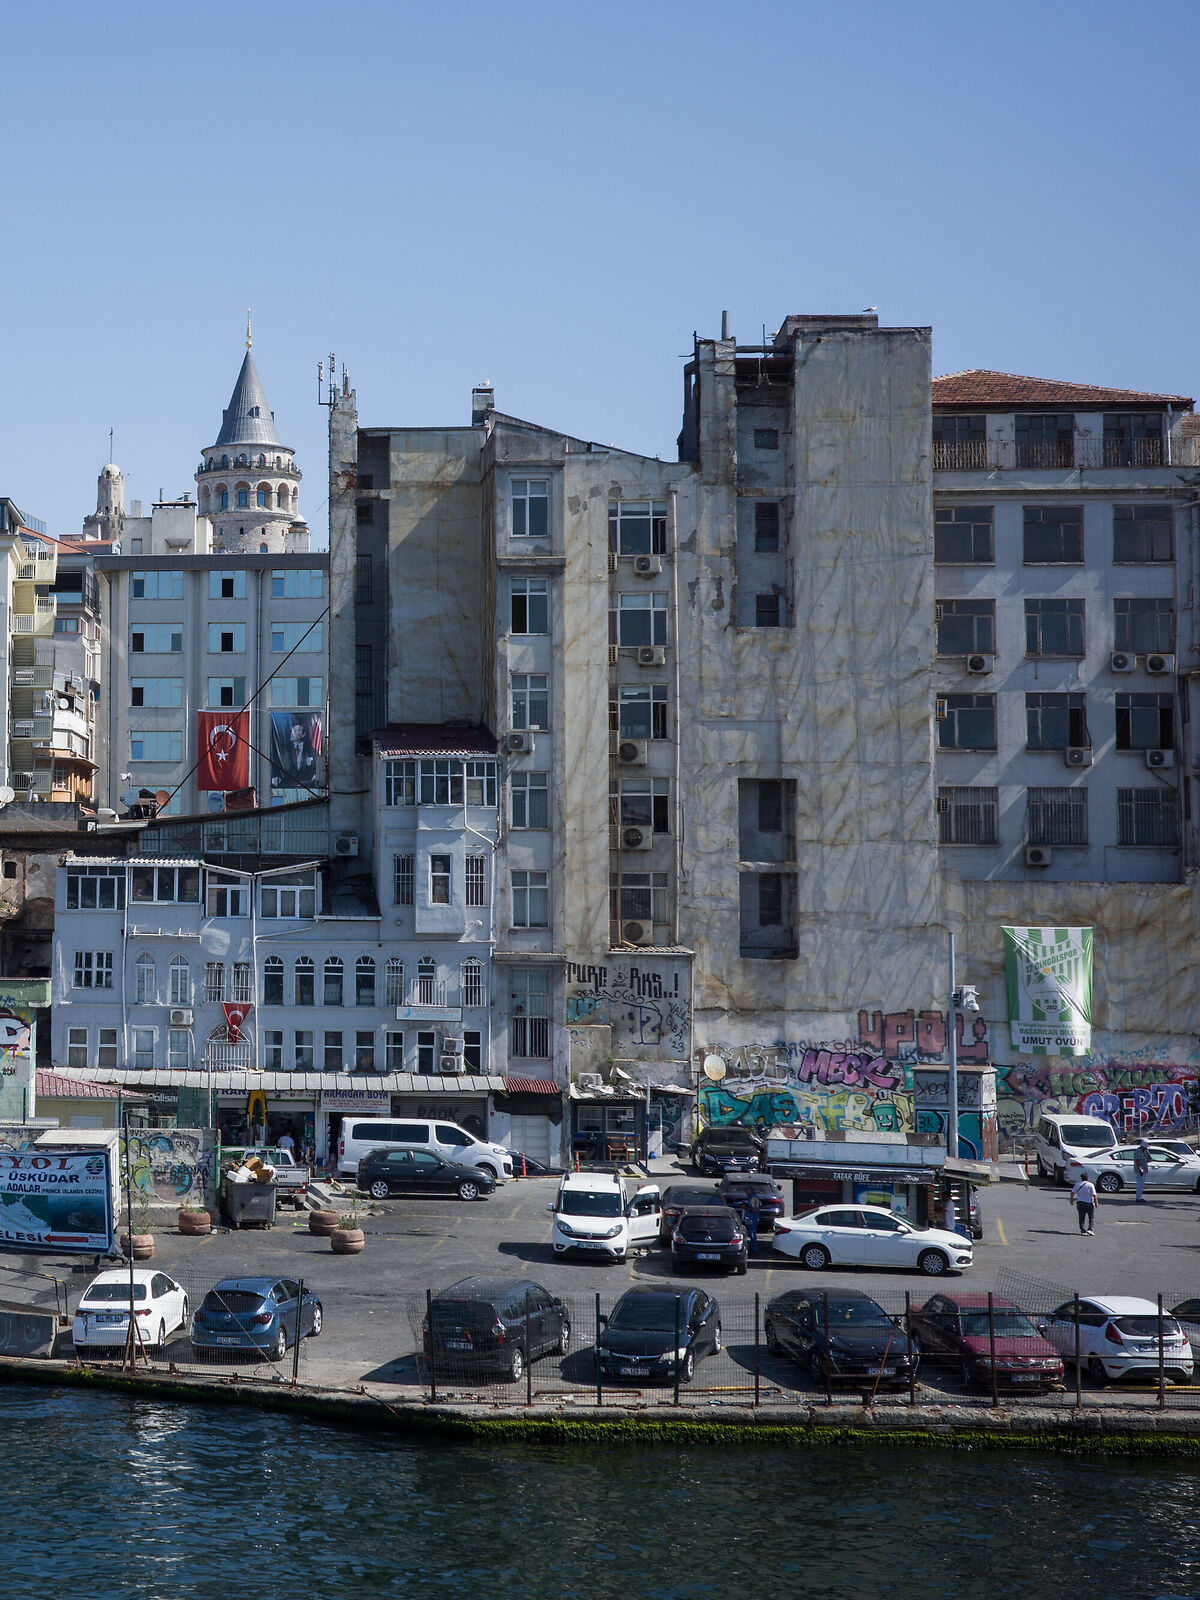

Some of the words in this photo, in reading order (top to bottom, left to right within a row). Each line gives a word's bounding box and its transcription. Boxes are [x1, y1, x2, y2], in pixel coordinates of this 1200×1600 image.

[1022, 1037, 1052, 1045] UMUT
[367, 1090, 389, 1099] BOYA
[8, 1170, 80, 1184] ÜSKÜDAR
[833, 1172, 853, 1180] TATAR
[6, 1183, 41, 1193] ADALAR
